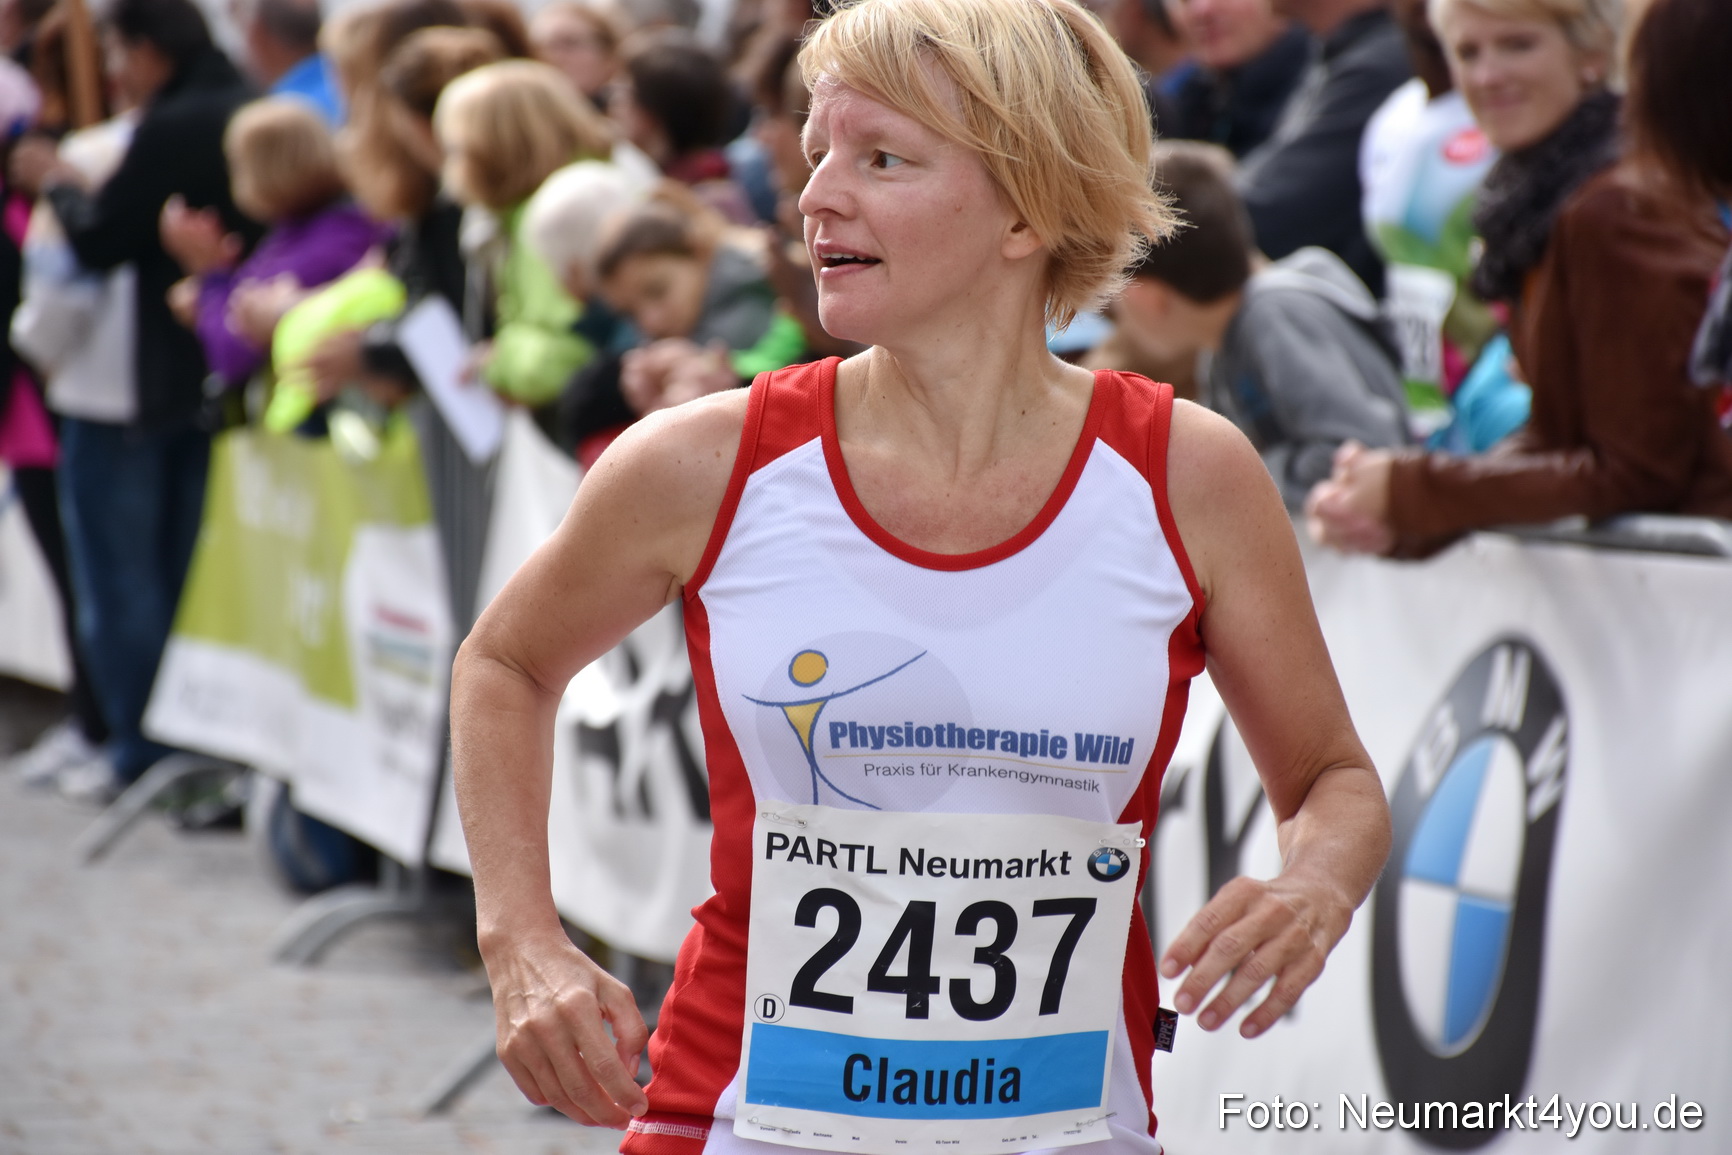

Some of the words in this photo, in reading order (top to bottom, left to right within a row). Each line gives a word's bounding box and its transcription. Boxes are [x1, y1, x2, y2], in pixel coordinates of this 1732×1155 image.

[829, 721, 1067, 759] Physiotherapie
[1074, 733, 1135, 765] Wild
[863, 763, 915, 777] Praxis
[919, 762, 942, 777] für
[948, 763, 1101, 793] Krankengymnastik
[765, 832, 887, 875] PARTL
[899, 848, 1072, 879] Neumarkt
[789, 887, 1098, 1021] 2437
[762, 997, 777, 1019] D
[842, 1053, 1021, 1106] Claudia
